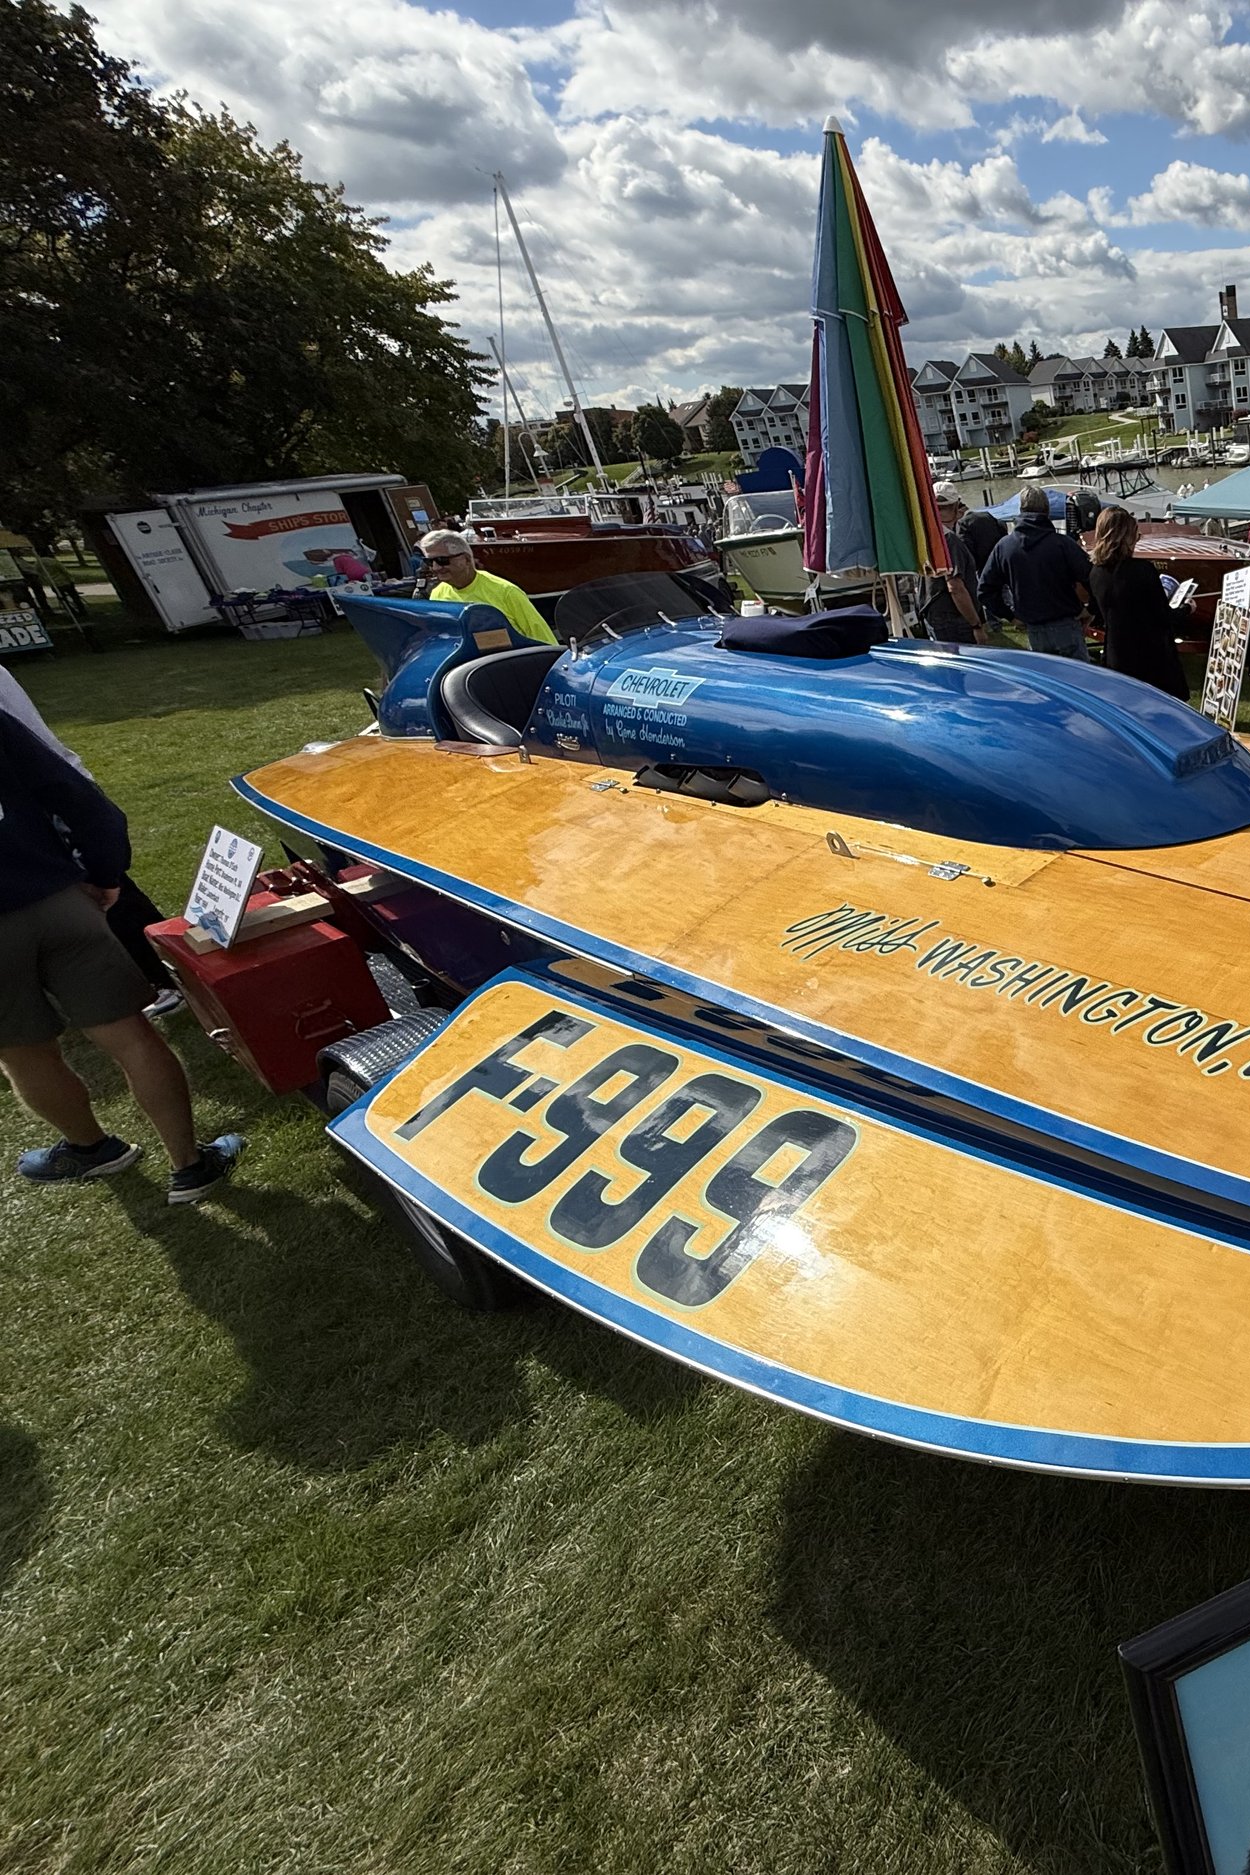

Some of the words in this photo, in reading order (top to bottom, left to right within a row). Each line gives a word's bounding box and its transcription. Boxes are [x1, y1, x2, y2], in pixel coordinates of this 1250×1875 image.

[194, 505, 238, 518] Michigan
[242, 502, 272, 514] Chapter
[621, 674, 690, 699] CHEVROLET
[603, 704, 636, 720] ARRANGED
[636, 708, 642, 721] &
[643, 709, 687, 726] CONDUCTED
[605, 719, 615, 742] by
[616, 720, 637, 744] Gene
[782, 904, 941, 960] Miss
[394, 1009, 860, 1312] F-999
